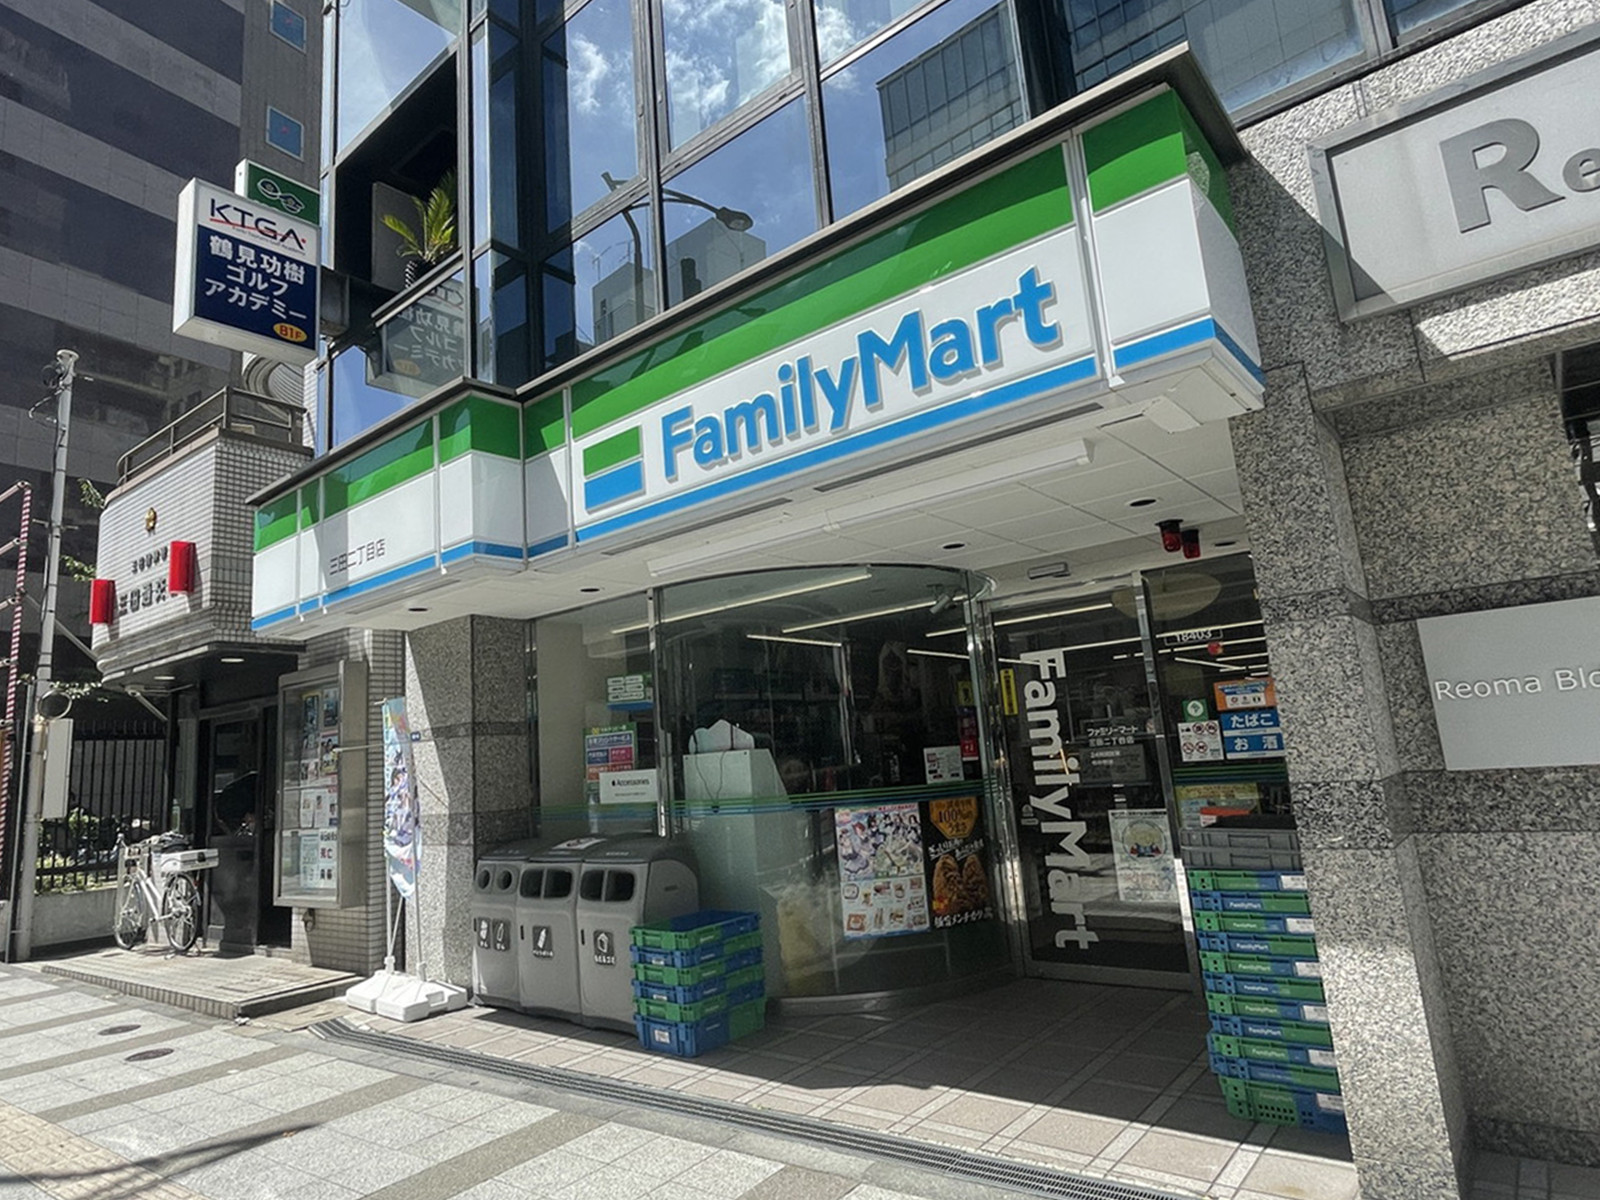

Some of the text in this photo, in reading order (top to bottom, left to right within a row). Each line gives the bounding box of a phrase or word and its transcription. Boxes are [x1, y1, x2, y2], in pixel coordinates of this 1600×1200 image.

[210, 198, 305, 250] KTGA
[210, 235, 305, 285] 鶴見功樹
[226, 265, 289, 296] ゴルフ
[204, 278, 307, 320] アカデミー
[279, 324, 303, 339] B1F
[662, 266, 1062, 483] FamilyMart
[329, 538, 386, 576] 三田二丁目店
[1434, 676, 1542, 700] Reoma
[1230, 713, 1275, 729] たばこ
[1020, 650, 1099, 950] FamilyMart
[1229, 902, 1262, 910] FamilyMart
[1236, 943, 1269, 952] FamilyMart
[1248, 1026, 1282, 1036] FamilyMart
[1252, 1048, 1286, 1058] FamilyMart
